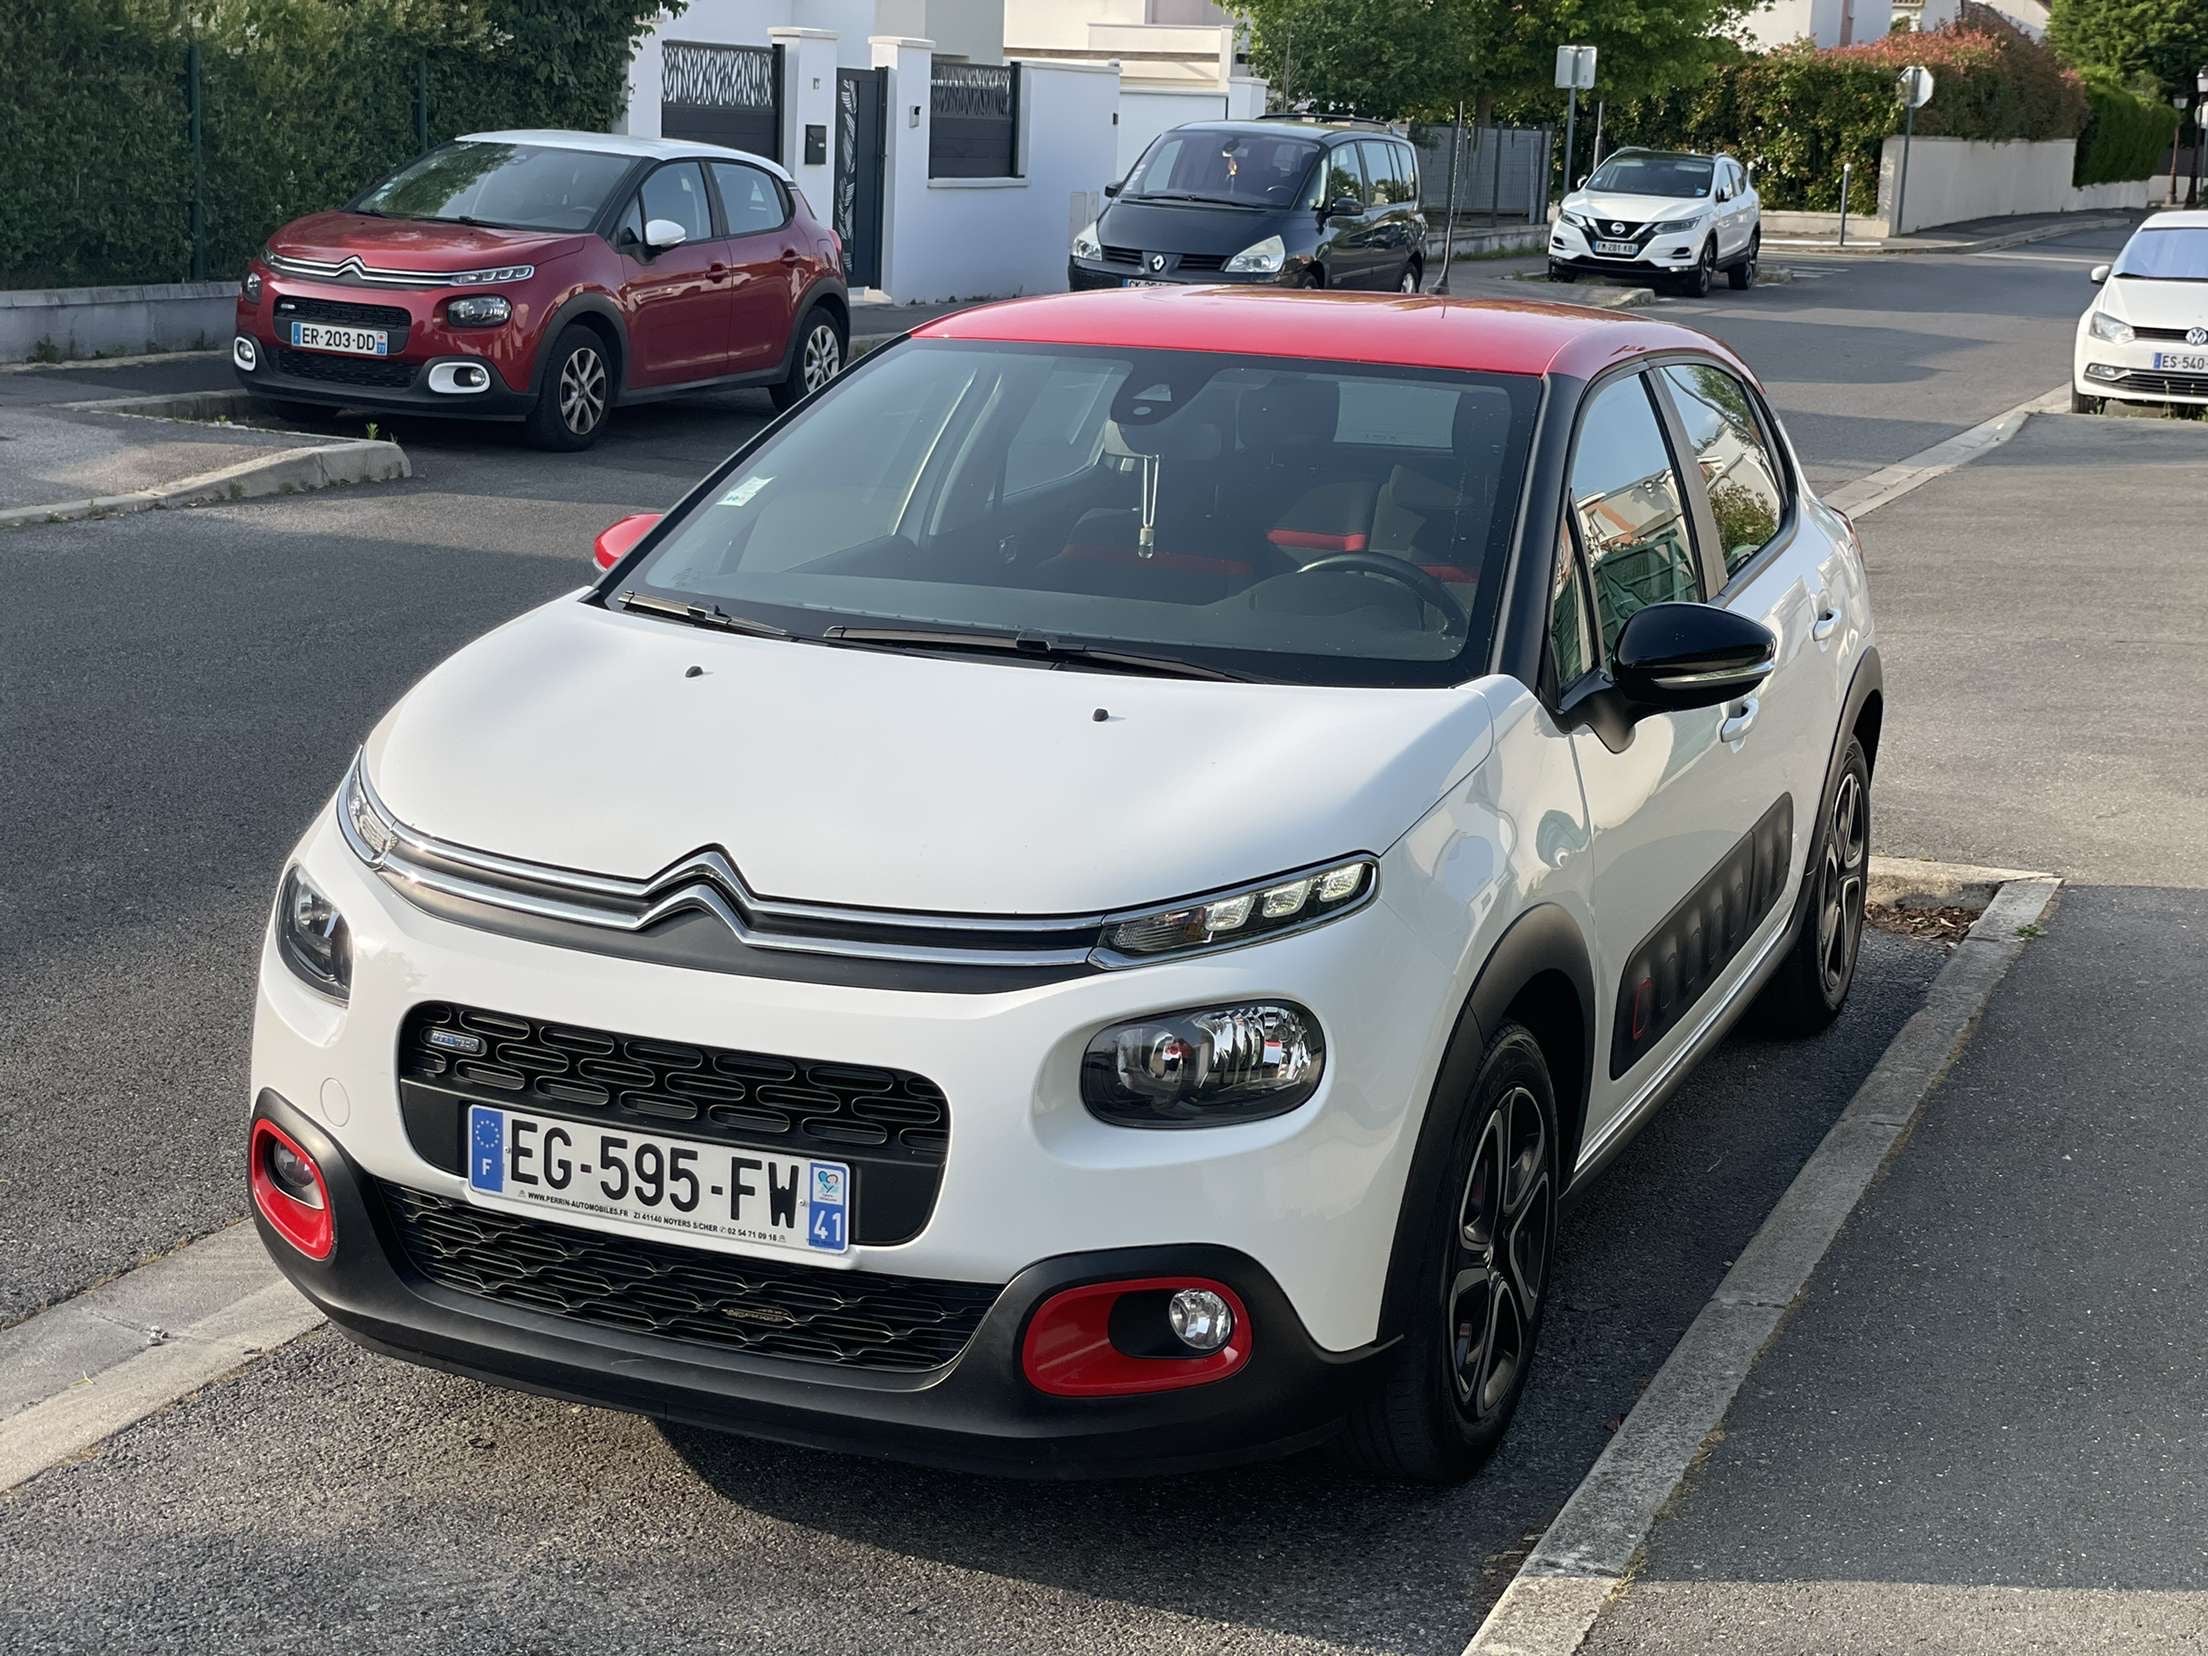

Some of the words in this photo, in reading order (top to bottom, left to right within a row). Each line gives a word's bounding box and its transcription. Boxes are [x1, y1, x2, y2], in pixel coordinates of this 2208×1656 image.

[302, 327, 375, 351] ER-203-DD
[481, 1158, 492, 1175] F
[511, 1118, 799, 1229] EG-595-FW
[641, 1213, 662, 1223] 41140
[663, 1216, 692, 1228] NOYERS
[727, 1227, 736, 1235] 02
[748, 1230, 756, 1238] 71
[813, 1209, 841, 1242] 41
